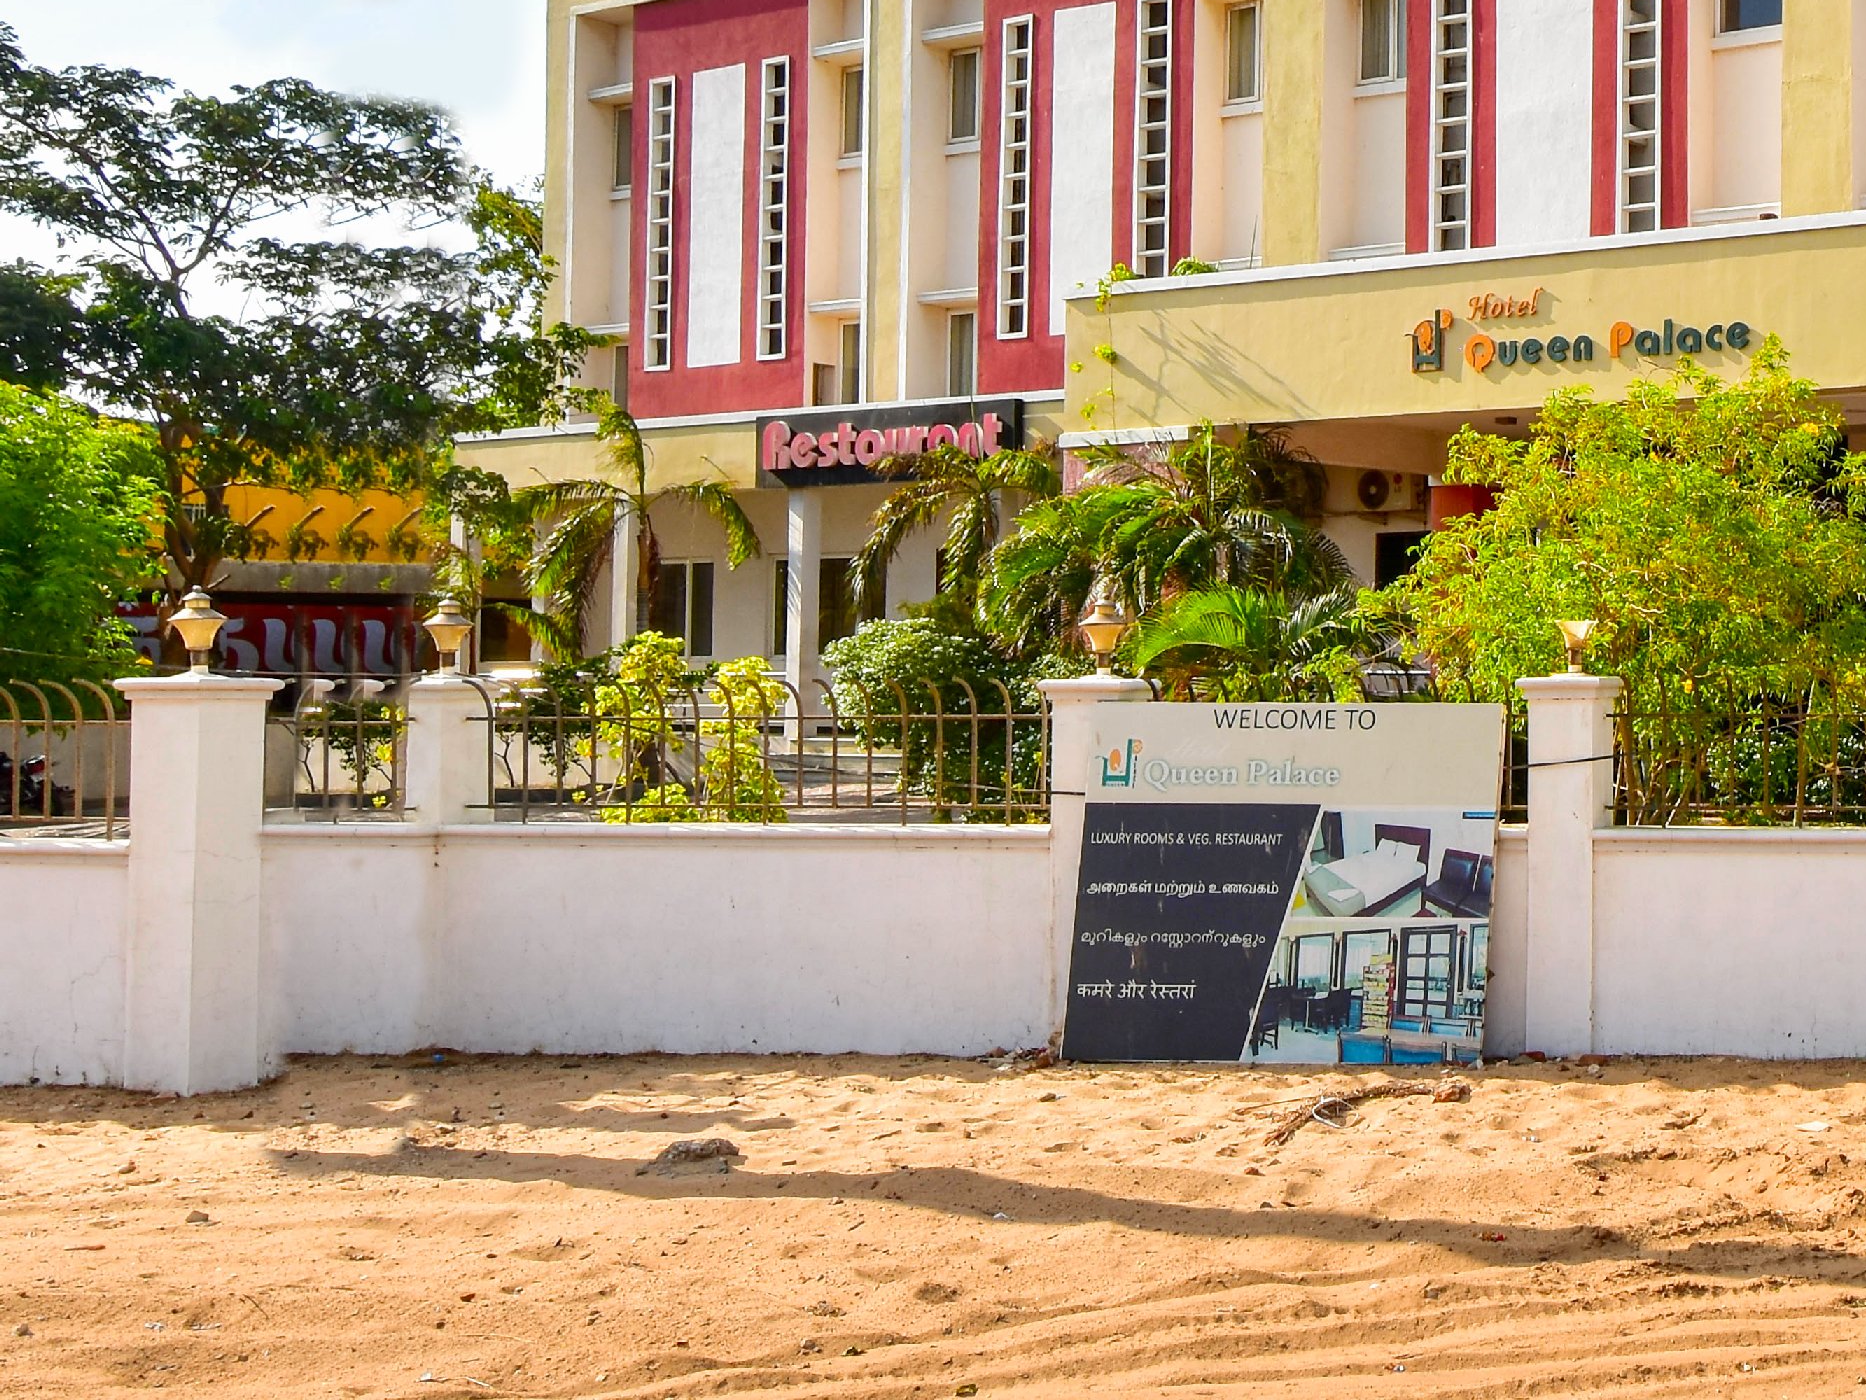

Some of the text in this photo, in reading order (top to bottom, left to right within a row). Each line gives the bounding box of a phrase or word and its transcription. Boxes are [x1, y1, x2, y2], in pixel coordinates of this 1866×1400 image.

[1466, 288, 1543, 321] Hotel
[1465, 318, 1751, 374] Queen Palace
[1214, 709, 1376, 730] WELCOME TO
[1144, 760, 1238, 792] Queen
[1248, 759, 1340, 786] Palace
[1090, 832, 1283, 846] LUXURY ROOMS & VEG. RESTAURANT
[1086, 880, 1279, 898] அறைகள் மற்றும் உணவகம்
[1076, 979, 1197, 999] कमरे और रेस्तरां
